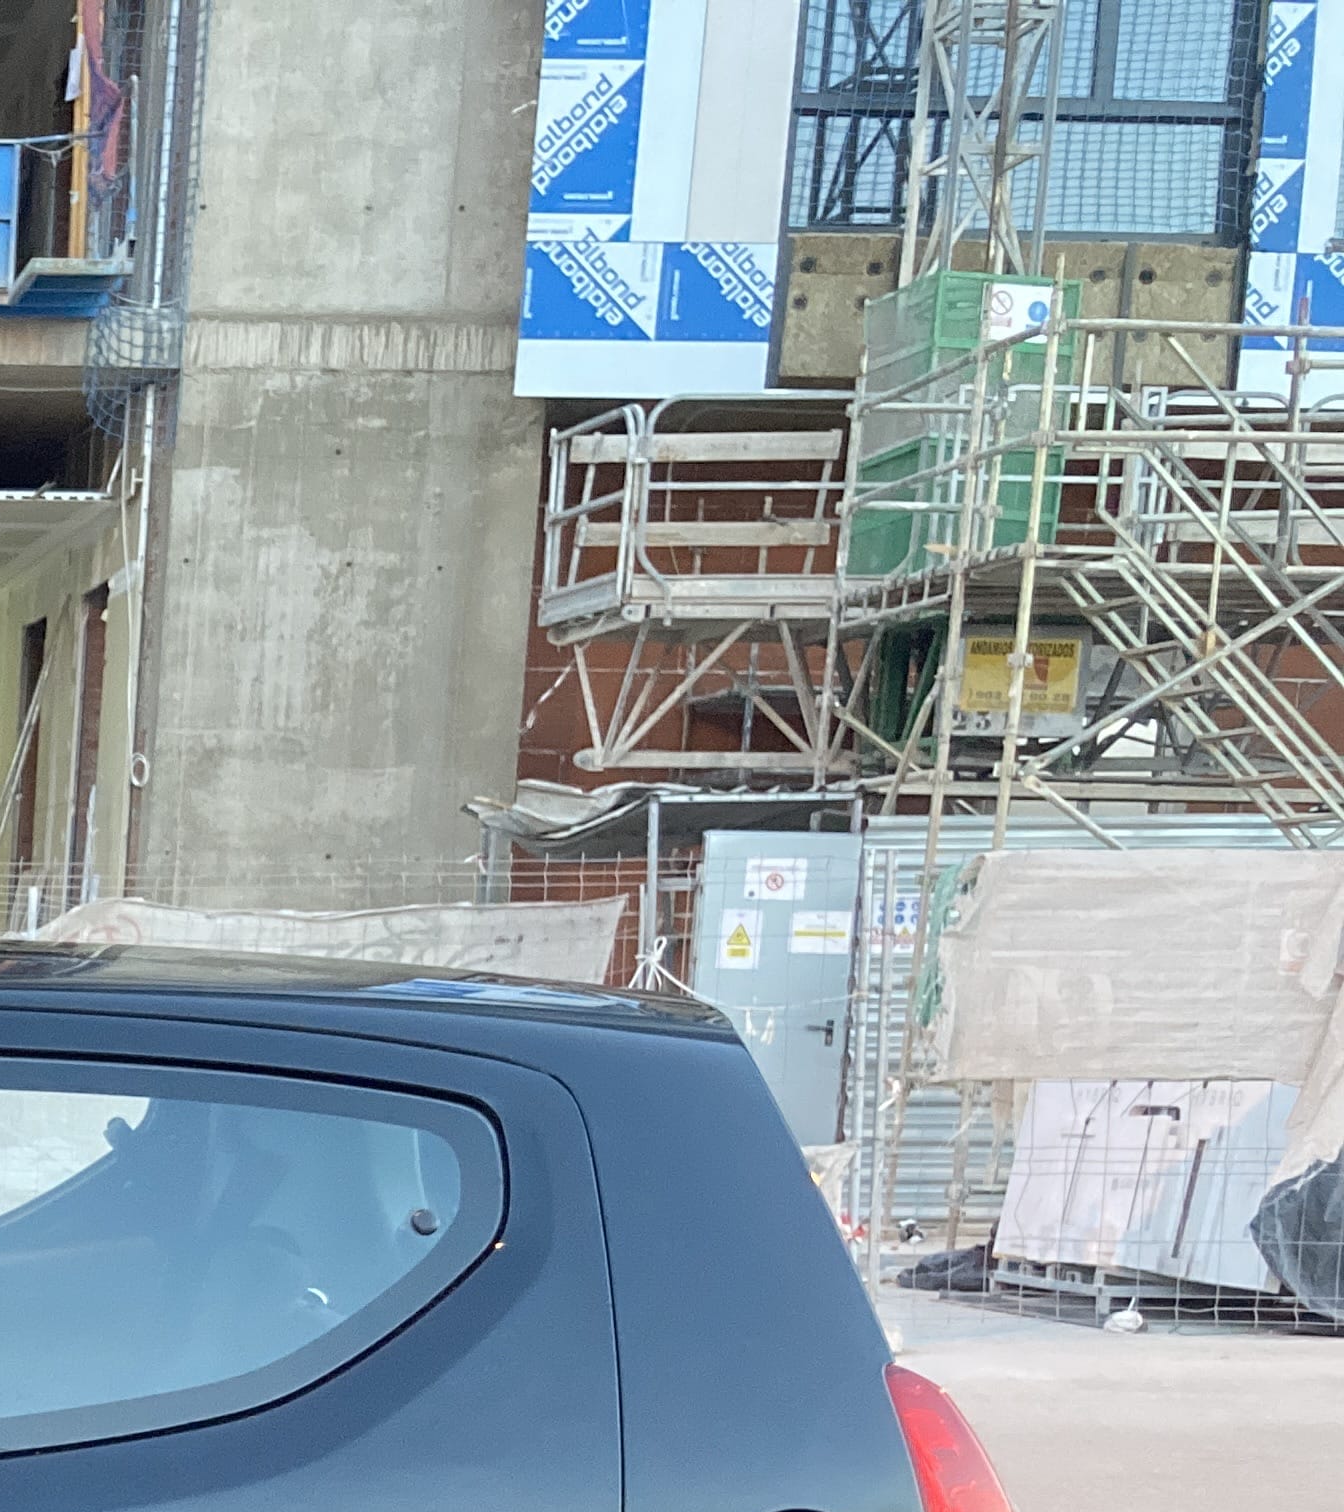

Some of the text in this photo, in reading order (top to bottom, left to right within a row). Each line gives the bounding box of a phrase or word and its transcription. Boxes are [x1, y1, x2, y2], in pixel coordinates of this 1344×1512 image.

[531, 93, 627, 196] etalbond
[535, 72, 613, 157] albond
[1028, 642, 1075, 658] TORIZADOS
